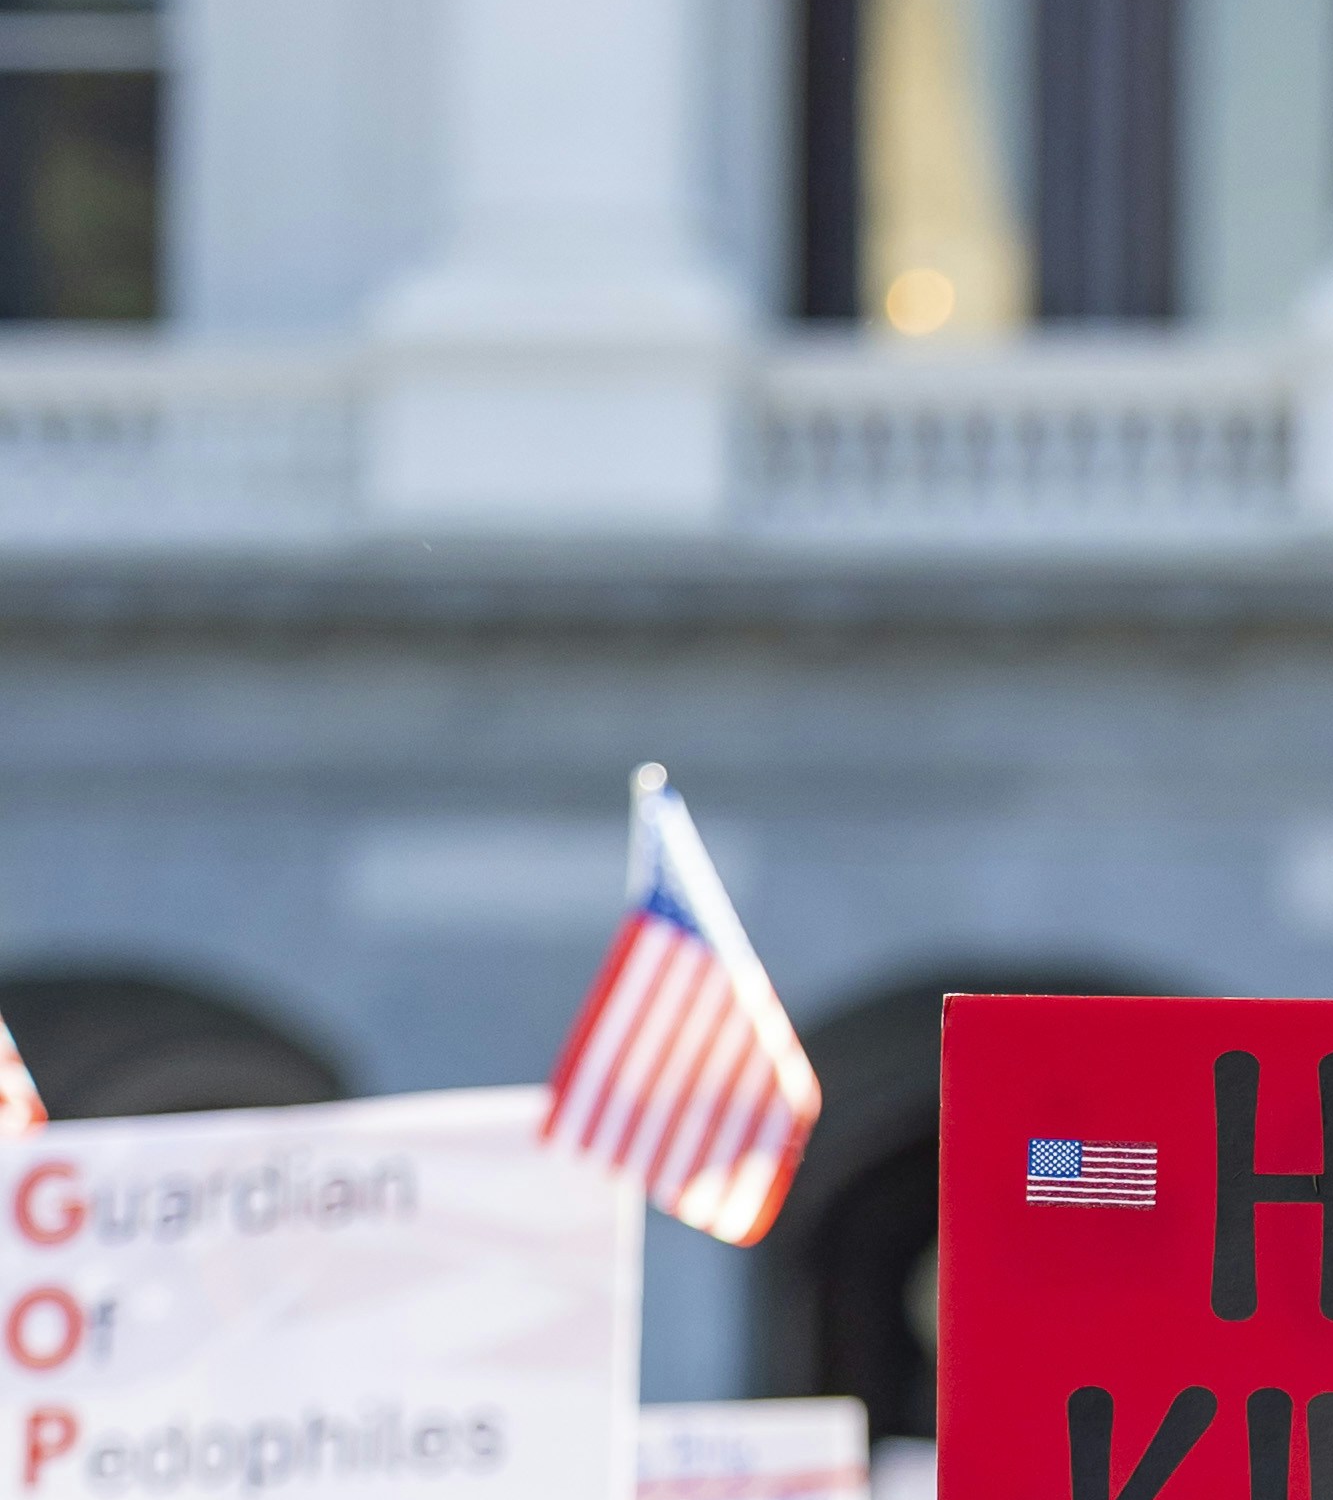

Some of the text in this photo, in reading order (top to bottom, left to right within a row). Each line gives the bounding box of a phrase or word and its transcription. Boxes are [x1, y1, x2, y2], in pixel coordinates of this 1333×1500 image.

[14, 1150, 419, 1246] Guardian
[4, 1286, 119, 1370] Of
[22, 1402, 506, 1498] Pedophiles
